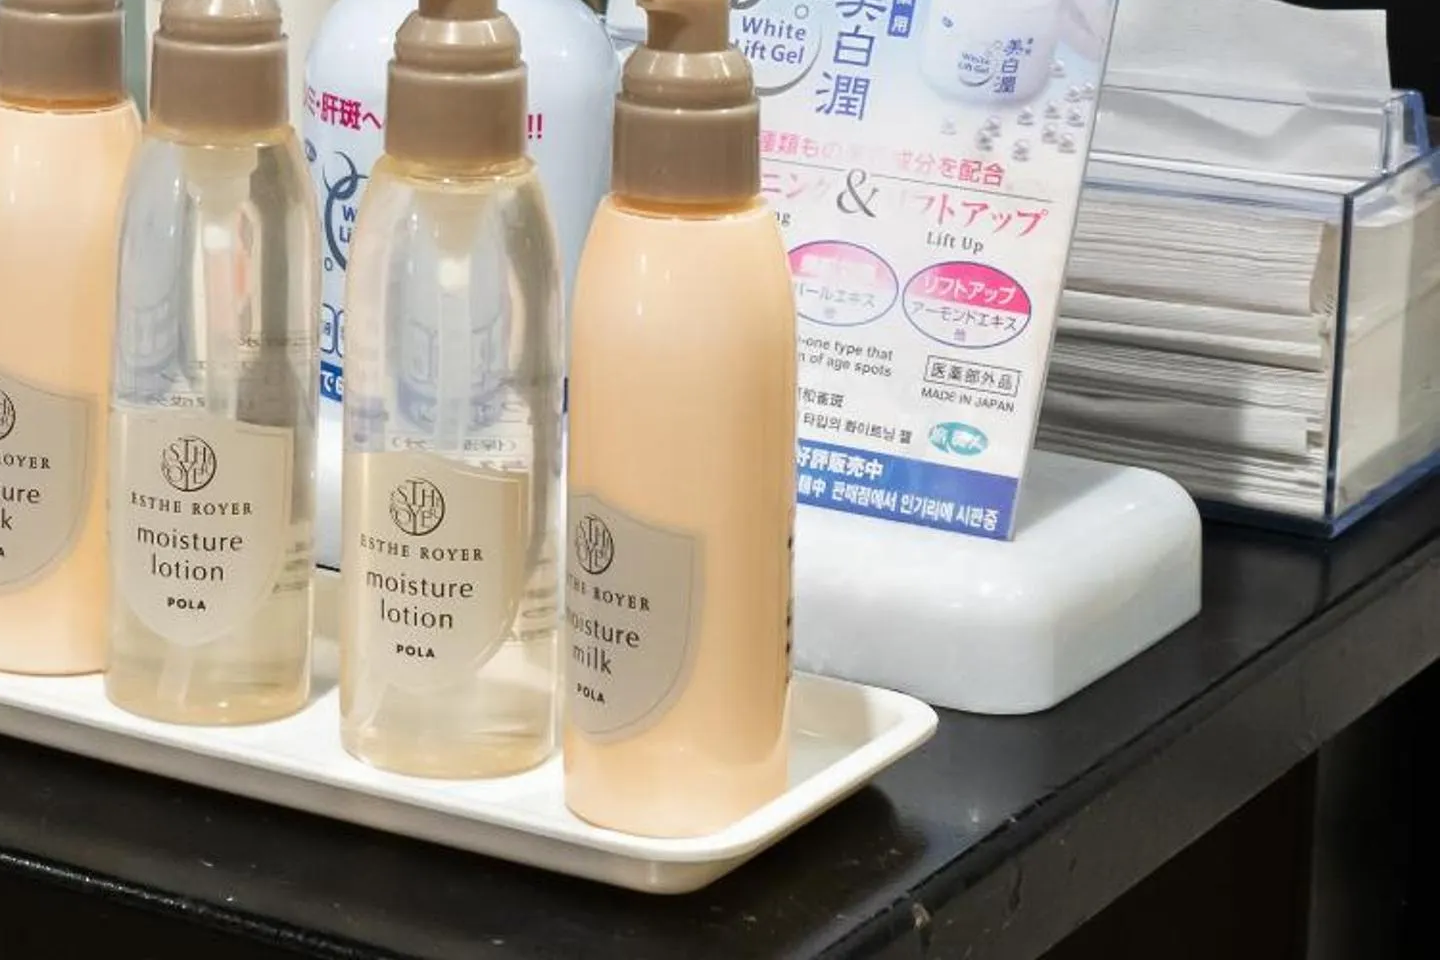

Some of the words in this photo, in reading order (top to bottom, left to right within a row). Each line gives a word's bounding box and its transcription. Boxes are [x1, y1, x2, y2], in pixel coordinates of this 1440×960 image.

[742, 15, 807, 41] White
[735, 38, 766, 60] ift
[771, 44, 805, 64] Gel
[837, 168, 879, 218] &
[926, 230, 957, 249] Lift
[962, 236, 984, 254] Up
[911, 301, 1018, 331] アーモンドエキス
[834, 340, 863, 356] type
[867, 346, 894, 361] that
[809, 353, 824, 365] of
[827, 357, 851, 371] age
[854, 362, 892, 377] spots
[930, 361, 1014, 390] 医薬部外品
[920, 387, 955, 404] MADE
[958, 393, 973, 405] IN
[975, 395, 1014, 413] JAPAN
[131, 492, 181, 514] ESTHE
[192, 501, 252, 516] ROYER
[138, 525, 243, 552] moisture
[360, 534, 410, 557] ESTHE
[420, 545, 484, 561] ROYER
[151, 553, 225, 582] lotion
[366, 570, 474, 598] moisture
[167, 597, 206, 610] POLA
[593, 587, 650, 611] ROYER
[381, 599, 454, 629] lotion
[396, 644, 435, 658] POLA
[573, 645, 612, 674] milk
